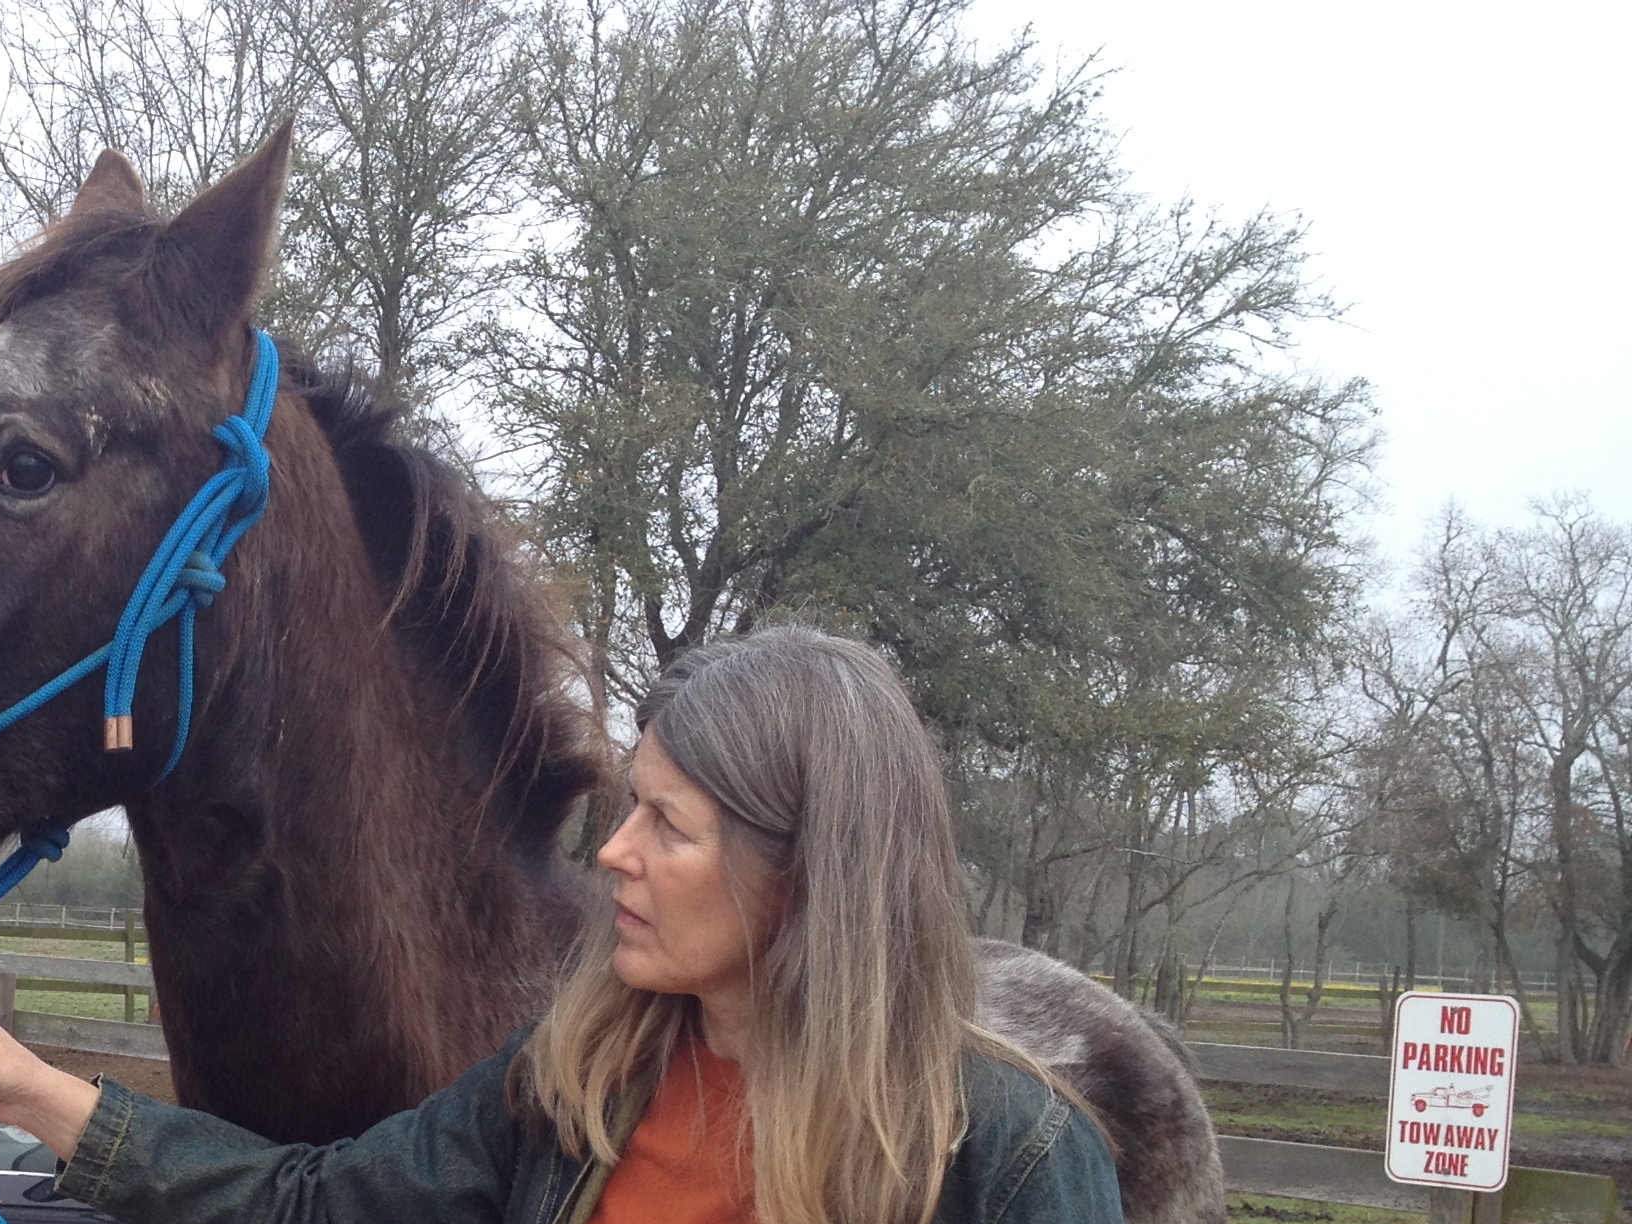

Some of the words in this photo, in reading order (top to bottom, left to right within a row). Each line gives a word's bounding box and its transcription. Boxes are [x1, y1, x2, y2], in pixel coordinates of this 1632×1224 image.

[1440, 1006, 1471, 1034] NO
[1402, 1042, 1505, 1076] PARKING
[1399, 1120, 1440, 1146] TOW
[1445, 1125, 1499, 1151] AWAY
[1424, 1151, 1469, 1177] ZONE
